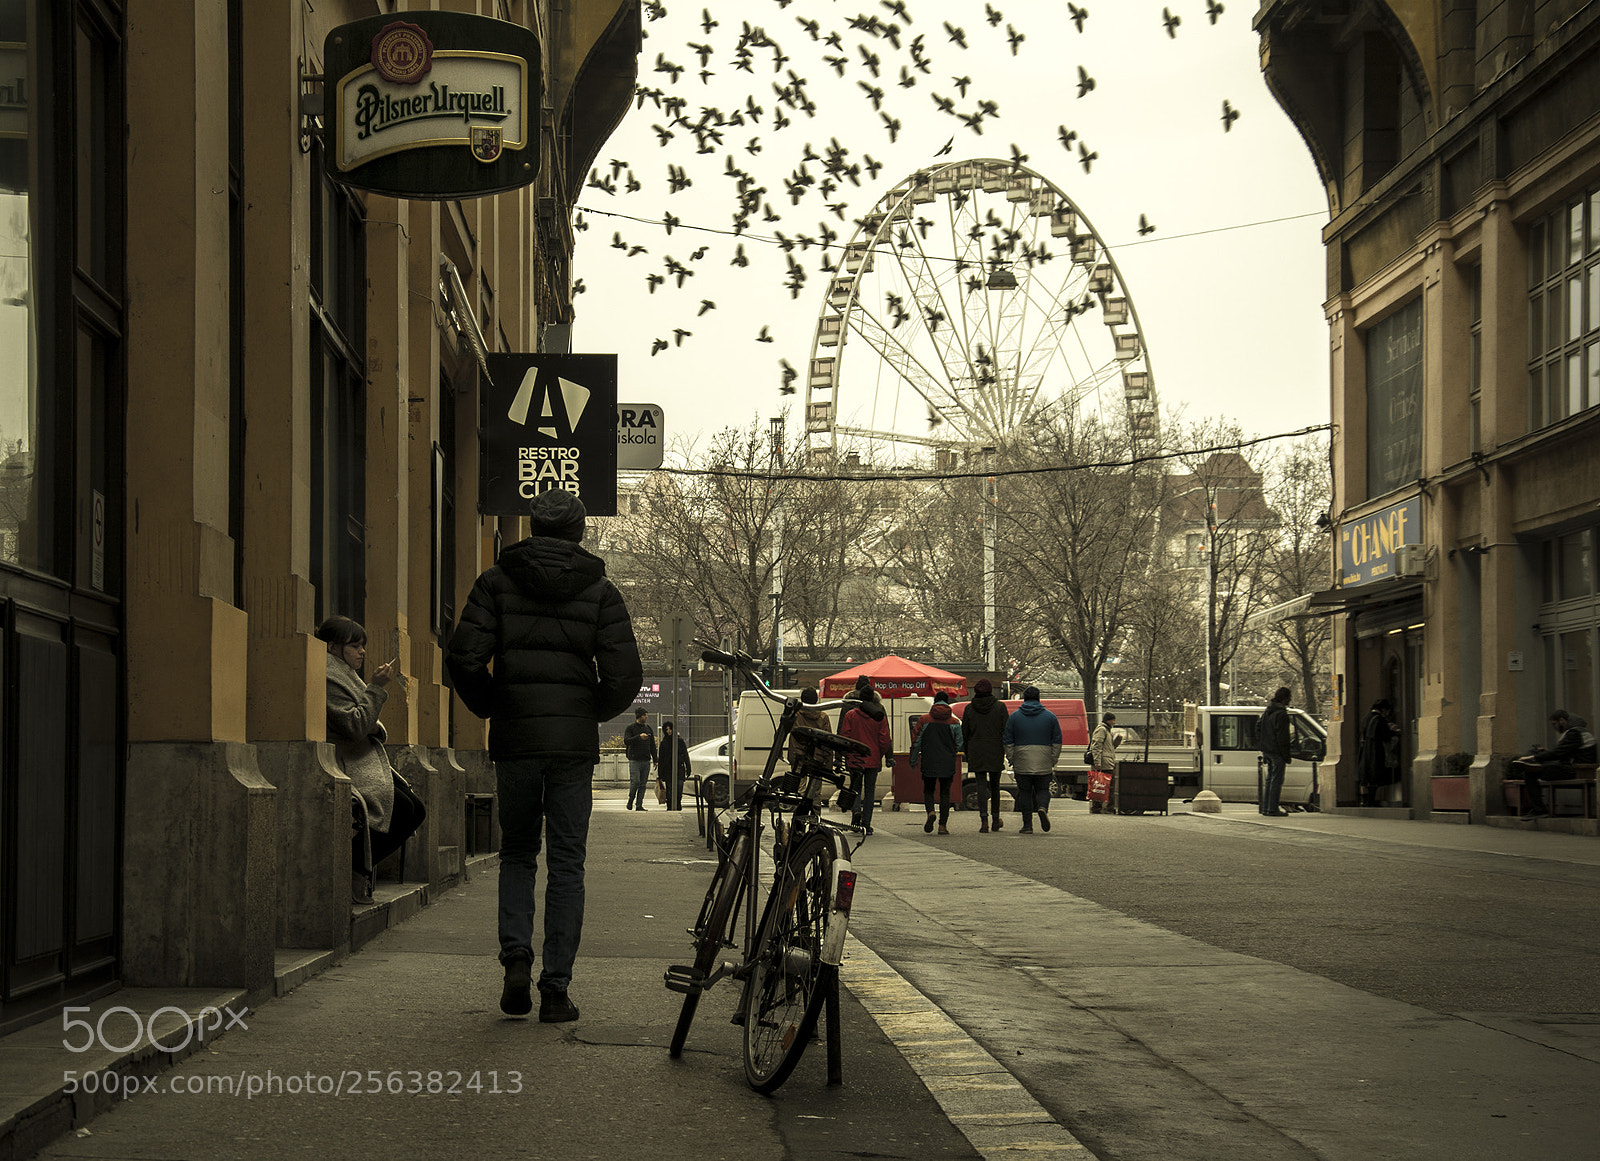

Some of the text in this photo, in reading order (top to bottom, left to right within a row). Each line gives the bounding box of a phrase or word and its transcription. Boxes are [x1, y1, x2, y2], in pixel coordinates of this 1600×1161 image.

[355, 81, 506, 140] Pilsner Urquell
[617, 410, 656, 428] RA
[518, 447, 580, 460] RESTRO
[518, 459, 580, 481] BAR
[1352, 507, 1408, 566] CHANGE
[874, 682, 887, 690] Hop
[901, 682, 915, 690] Hop
[915, 681, 926, 689] Off
